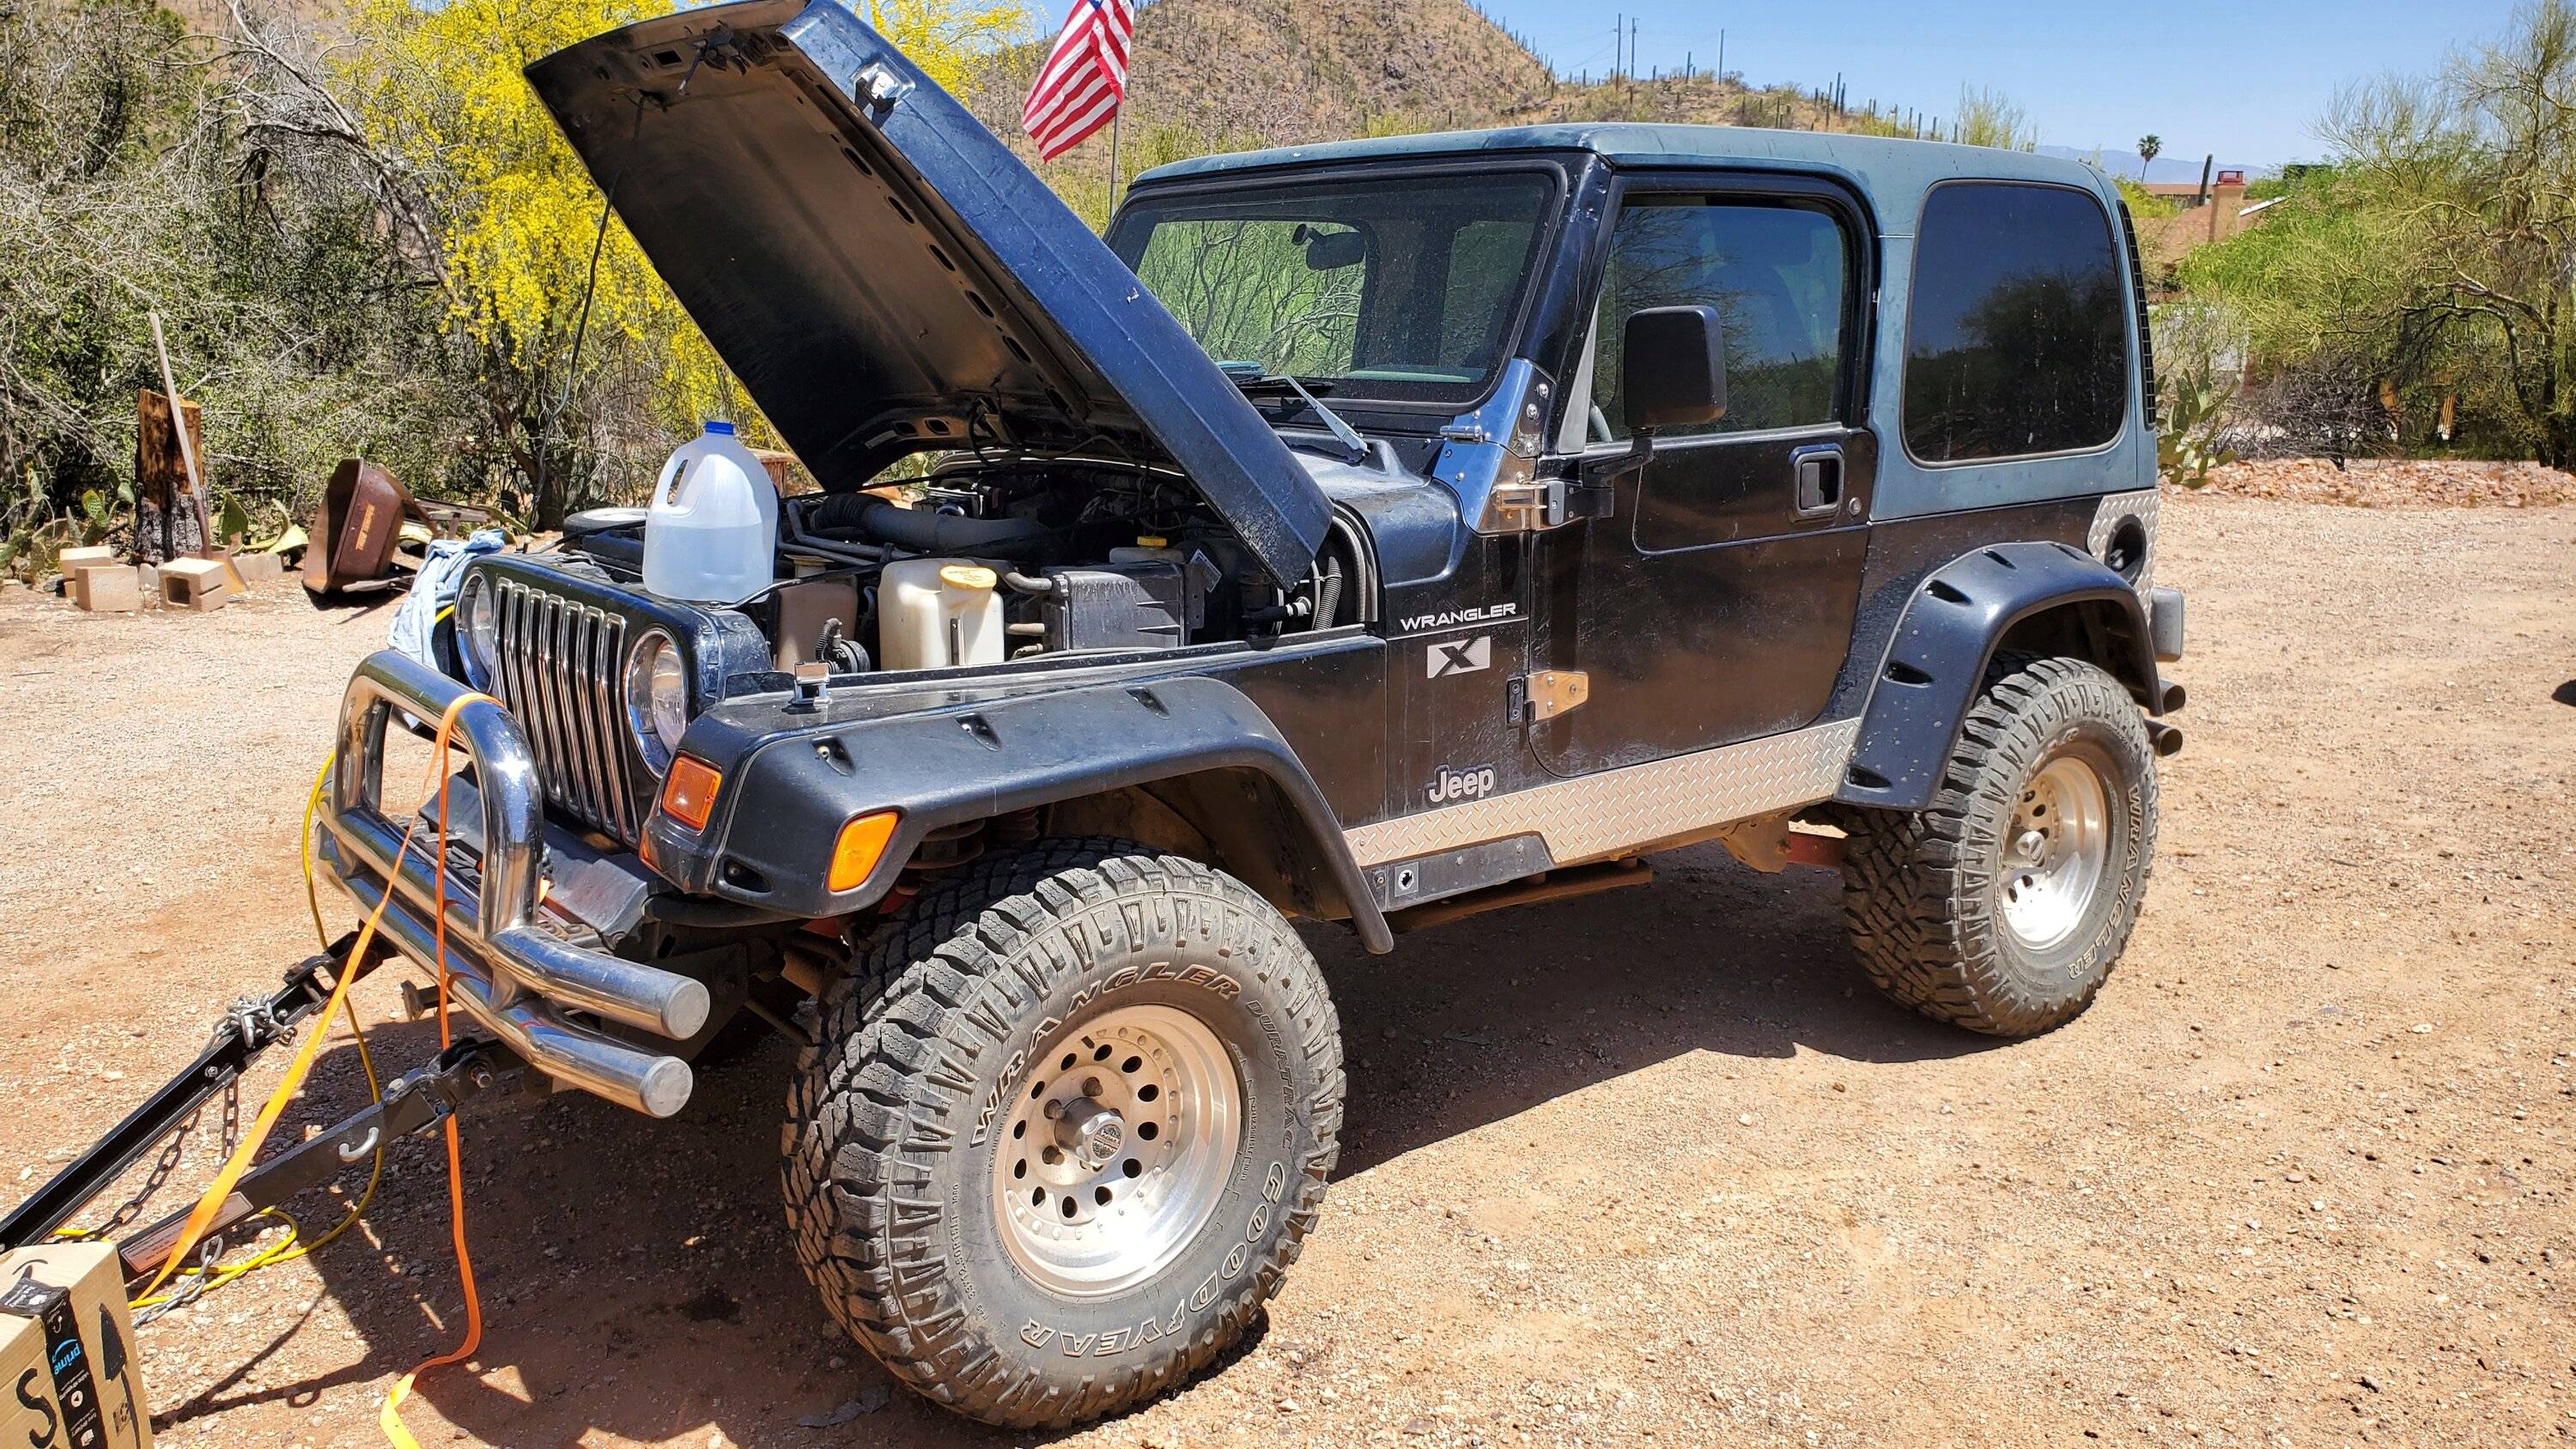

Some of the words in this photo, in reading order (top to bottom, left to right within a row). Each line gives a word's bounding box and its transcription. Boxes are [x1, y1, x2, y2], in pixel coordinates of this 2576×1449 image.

[1400, 603, 1516, 632] WRANGLER
[1427, 635, 1491, 678] X
[1428, 768, 1495, 803] Jeep
[2067, 783, 2142, 980] WRANGLER
[969, 961, 1242, 1149] WRANGLER
[1245, 999, 1295, 1150] DURATRAC
[1019, 1161, 1286, 1358] GOODYEAR
[53, 1342, 82, 1375] prime
